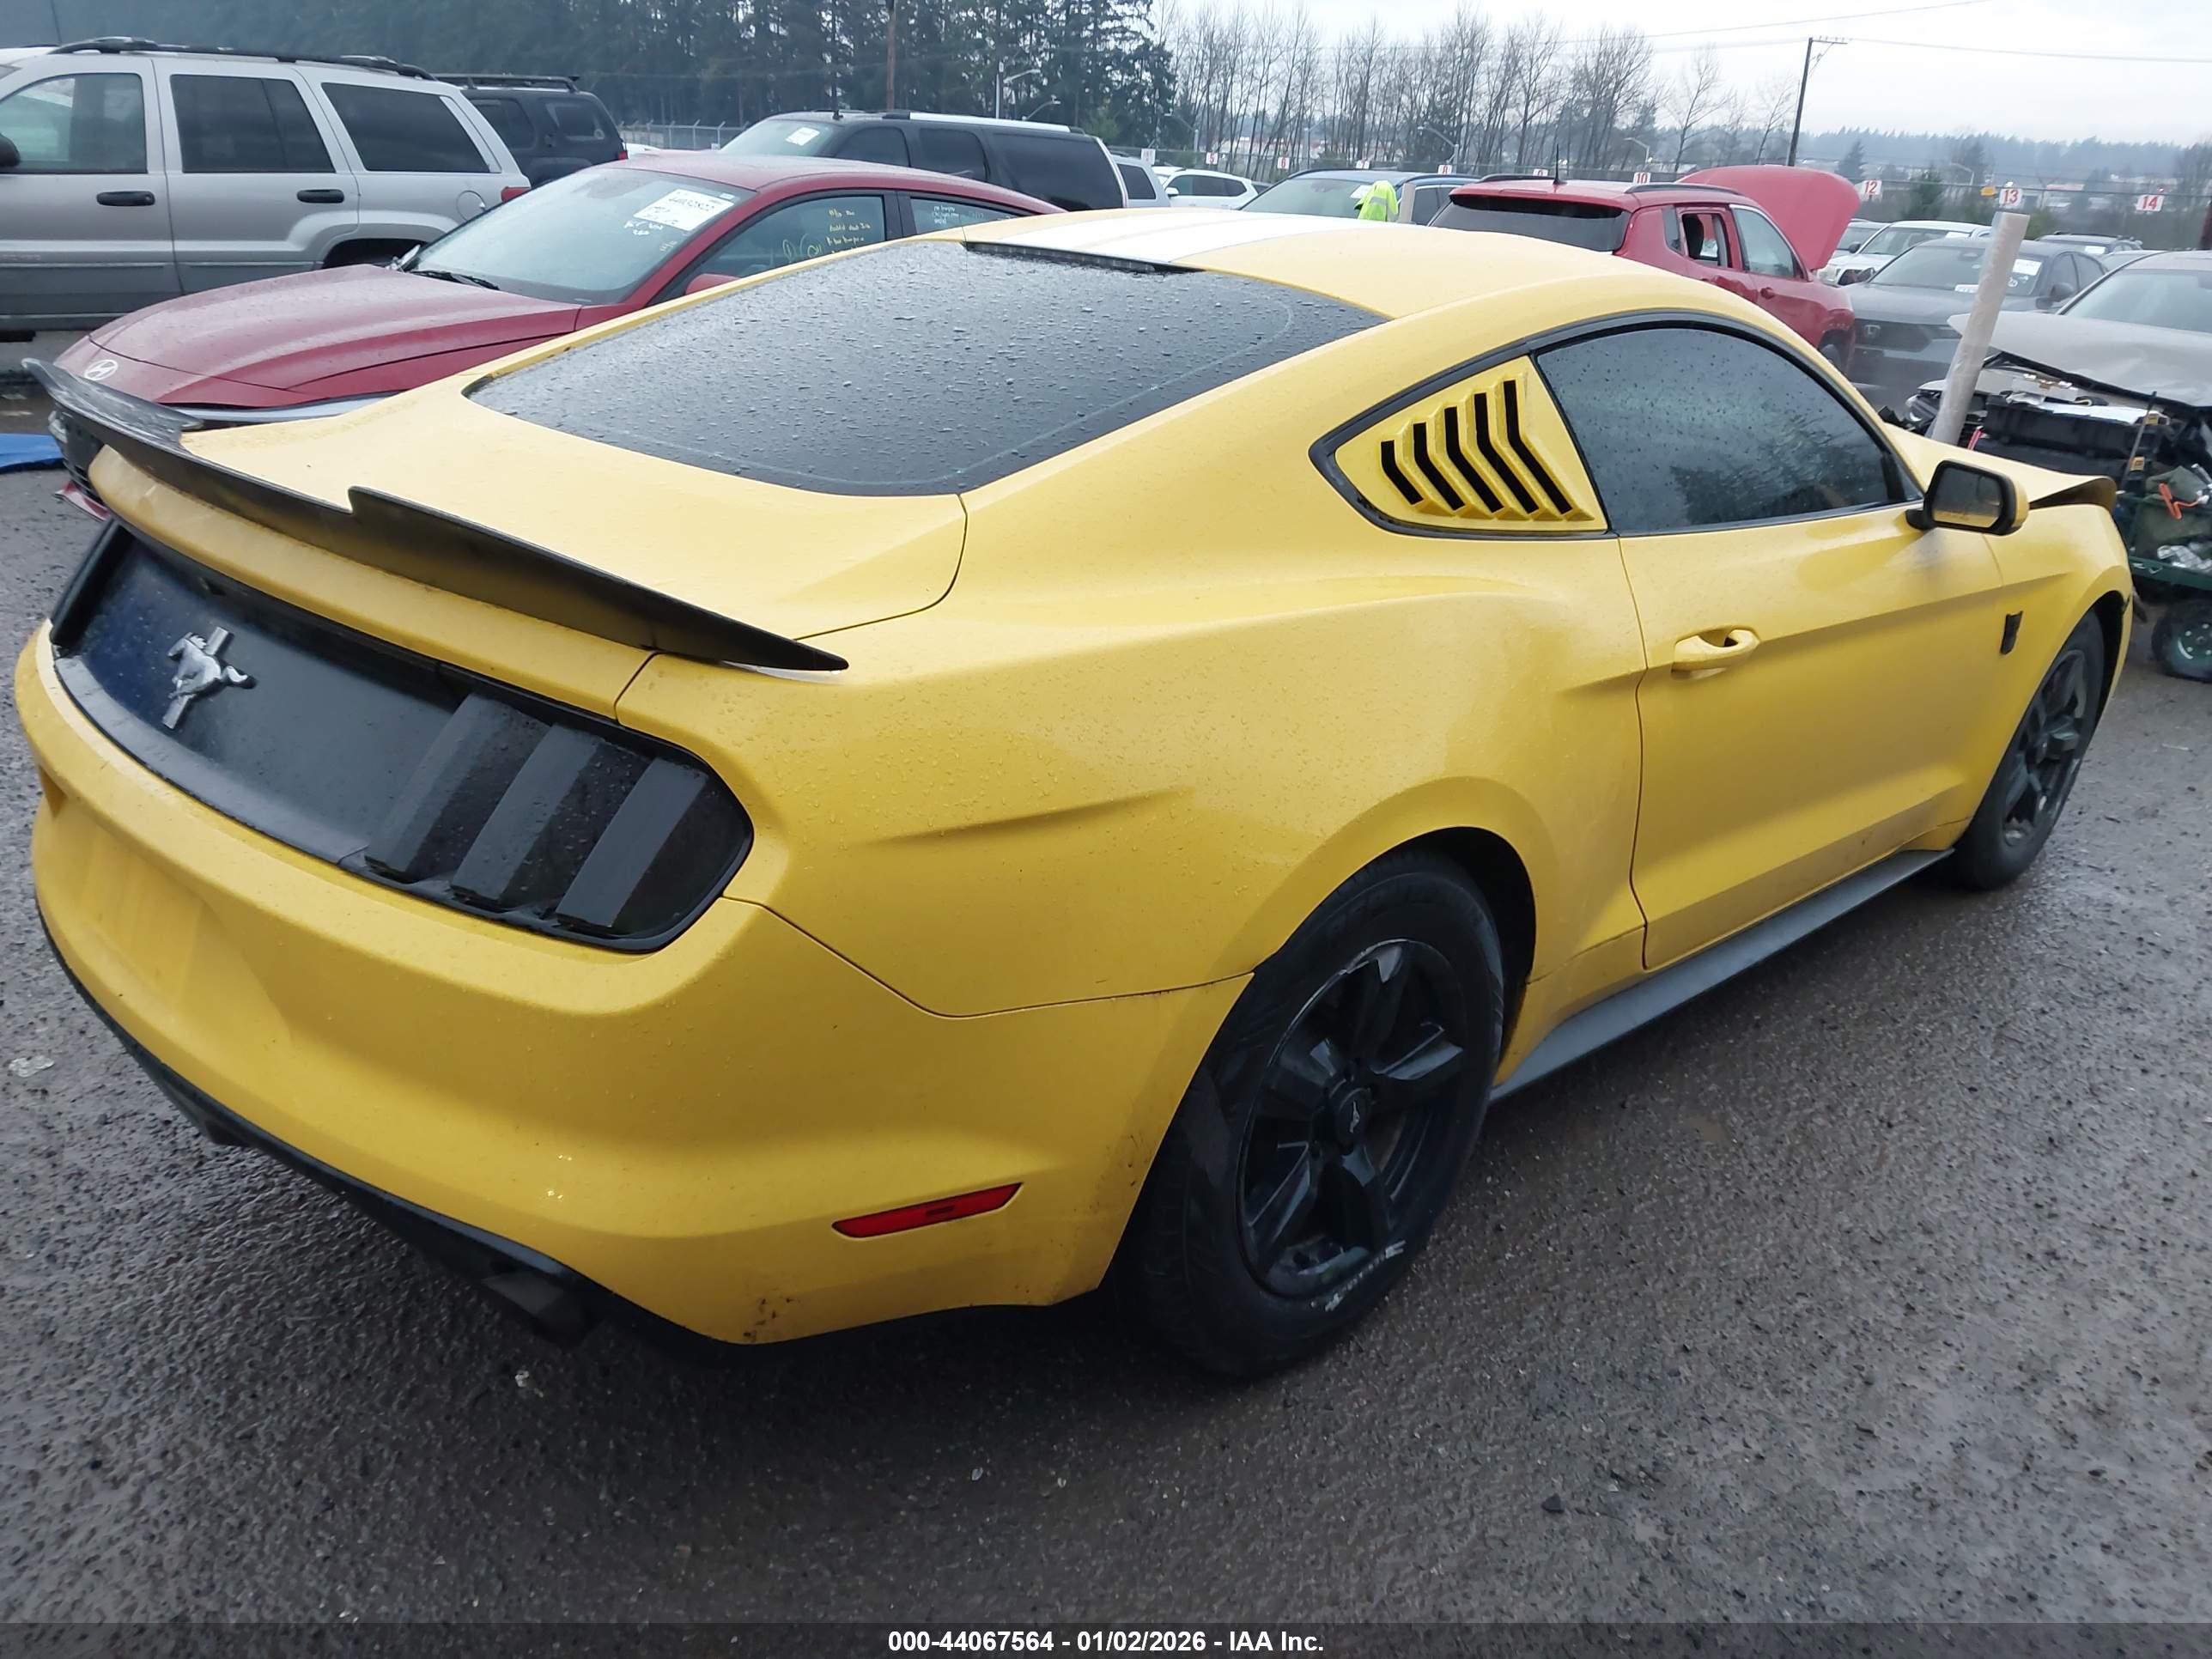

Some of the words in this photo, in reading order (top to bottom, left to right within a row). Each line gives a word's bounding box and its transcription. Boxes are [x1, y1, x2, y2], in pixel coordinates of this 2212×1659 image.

[1637, 173, 1649, 184] 10
[1864, 180, 1878, 194] 12
[2004, 189, 2019, 204] 13
[2142, 196, 2158, 210] 14
